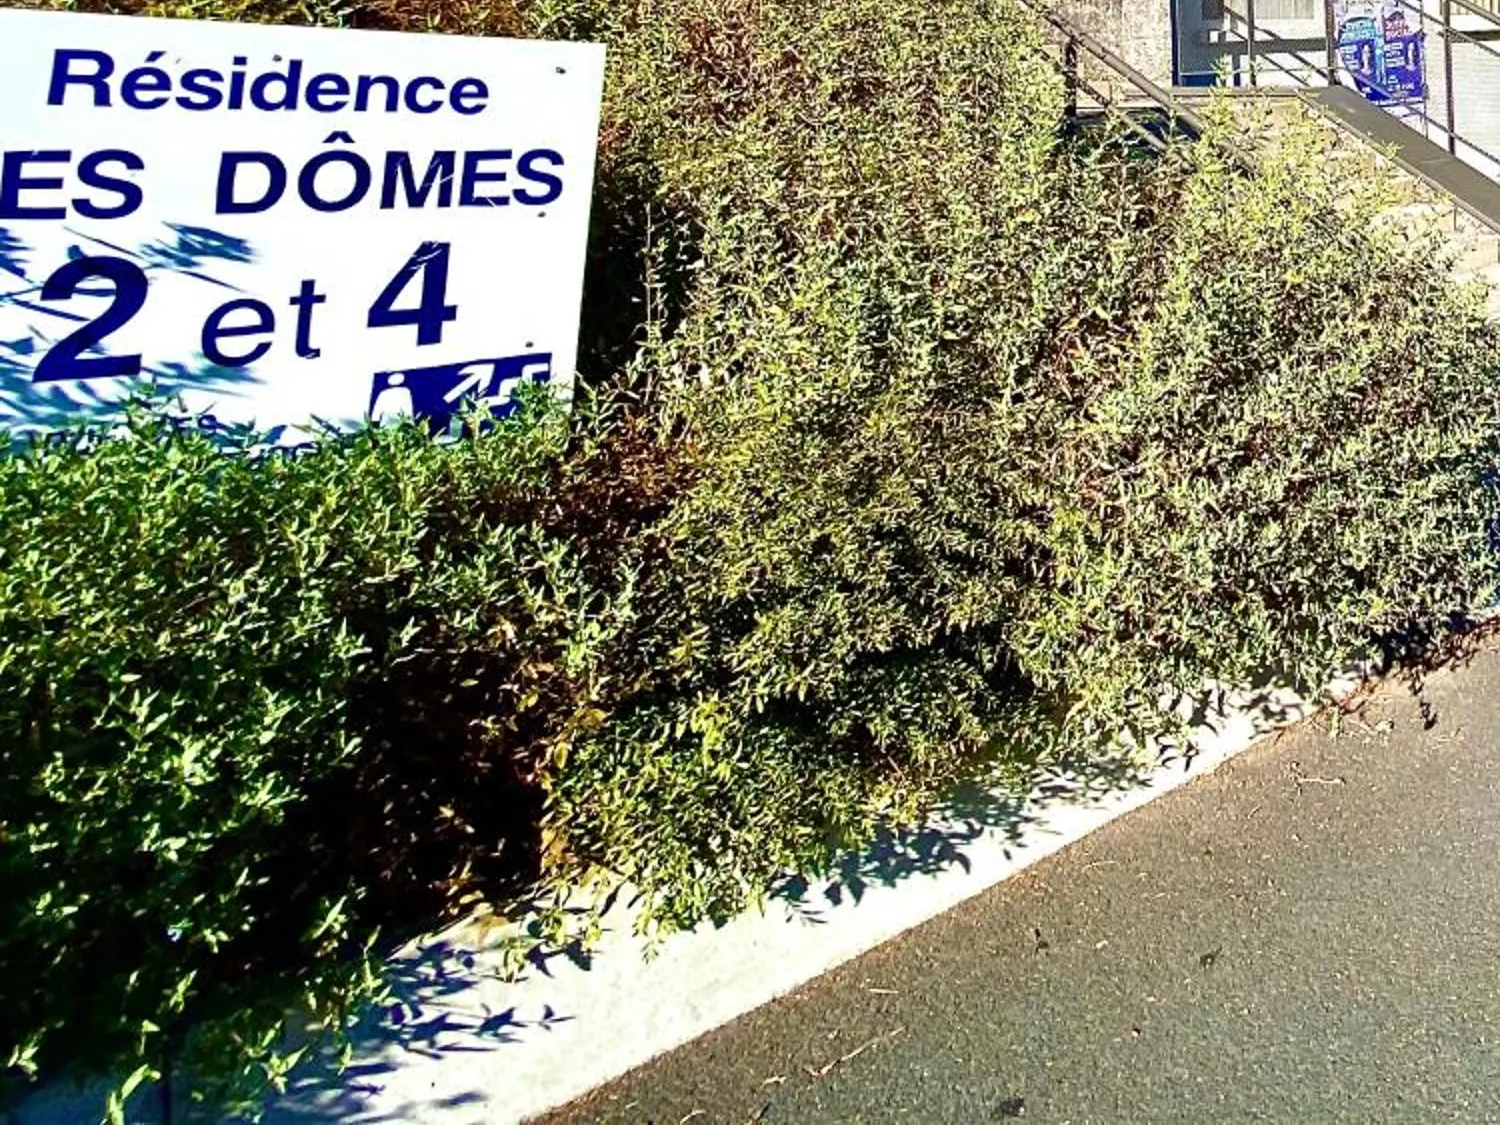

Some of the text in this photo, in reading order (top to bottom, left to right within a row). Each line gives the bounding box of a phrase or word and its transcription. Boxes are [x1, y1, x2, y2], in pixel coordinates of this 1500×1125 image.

[46, 48, 490, 115] Résidence
[0, 130, 565, 220] ES DÔMES
[32, 241, 458, 383] 2 et 4
